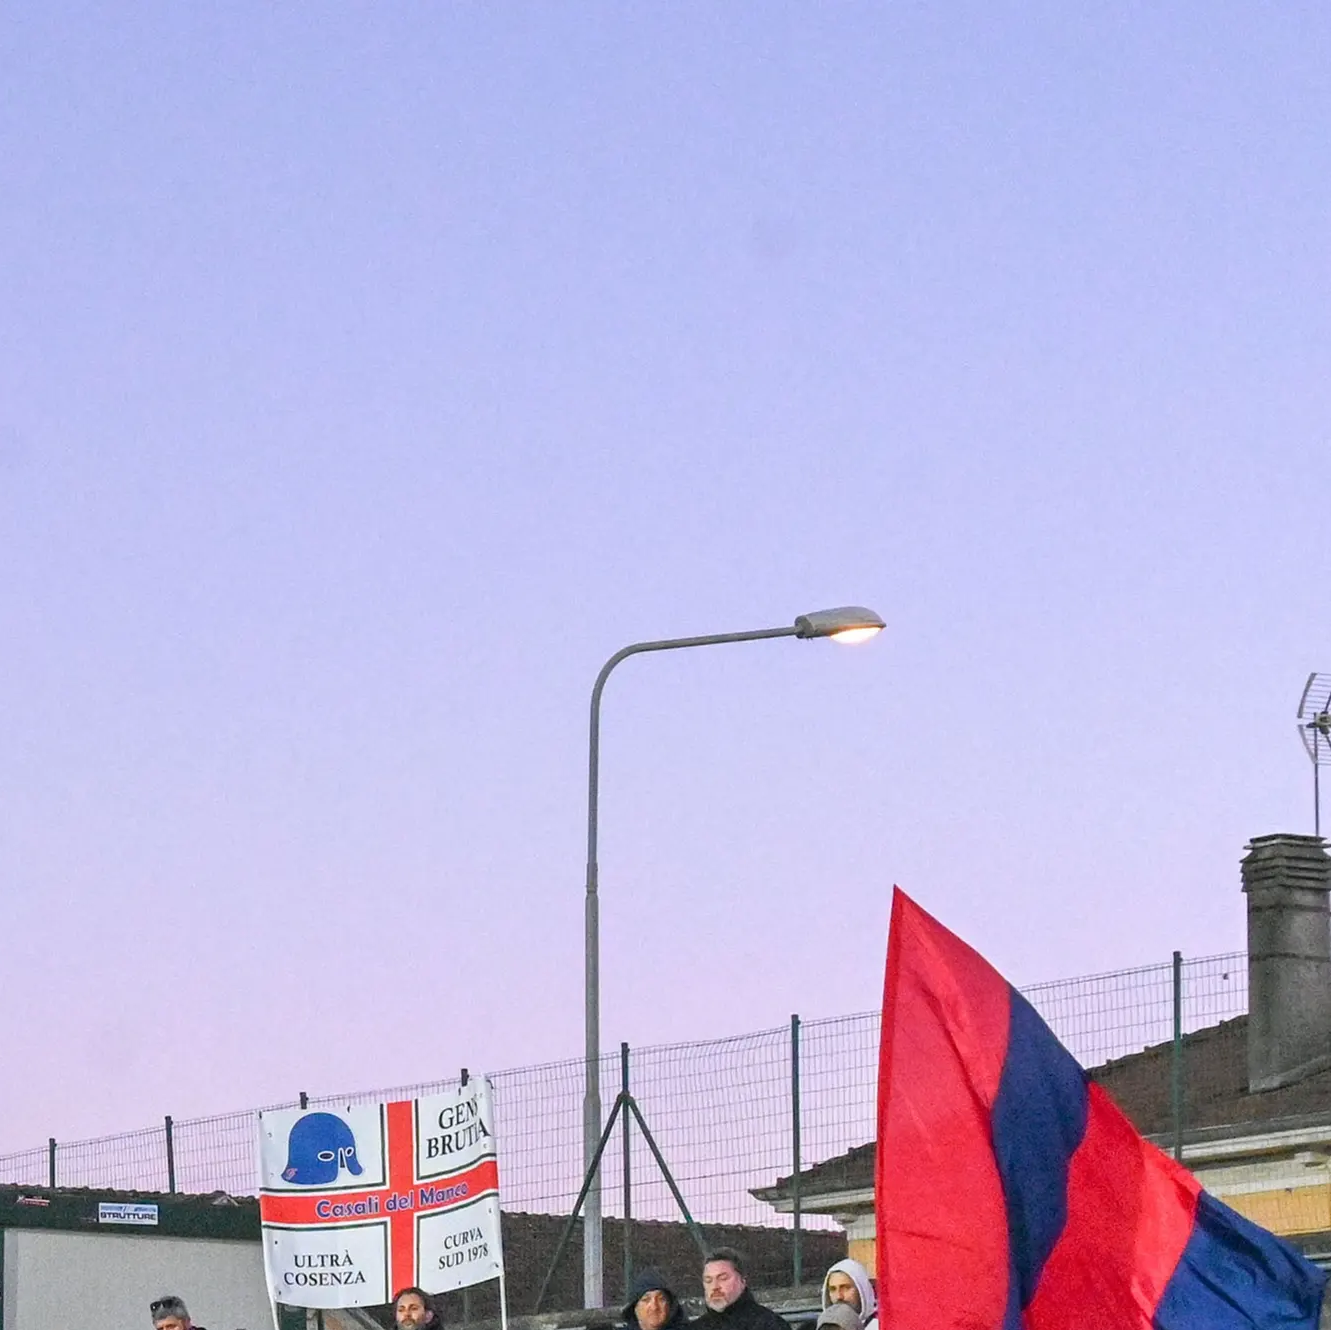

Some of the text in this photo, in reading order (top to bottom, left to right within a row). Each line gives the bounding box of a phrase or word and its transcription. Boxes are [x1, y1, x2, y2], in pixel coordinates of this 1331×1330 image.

[425, 1118, 491, 1159] BRUTIA
[316, 1181, 469, 1219] Casali del Manco
[444, 1227, 483, 1250] CURVA
[293, 1250, 354, 1268] ULTRÀ
[438, 1243, 489, 1270] SUD 1978
[283, 1271, 366, 1287] COSENZA
